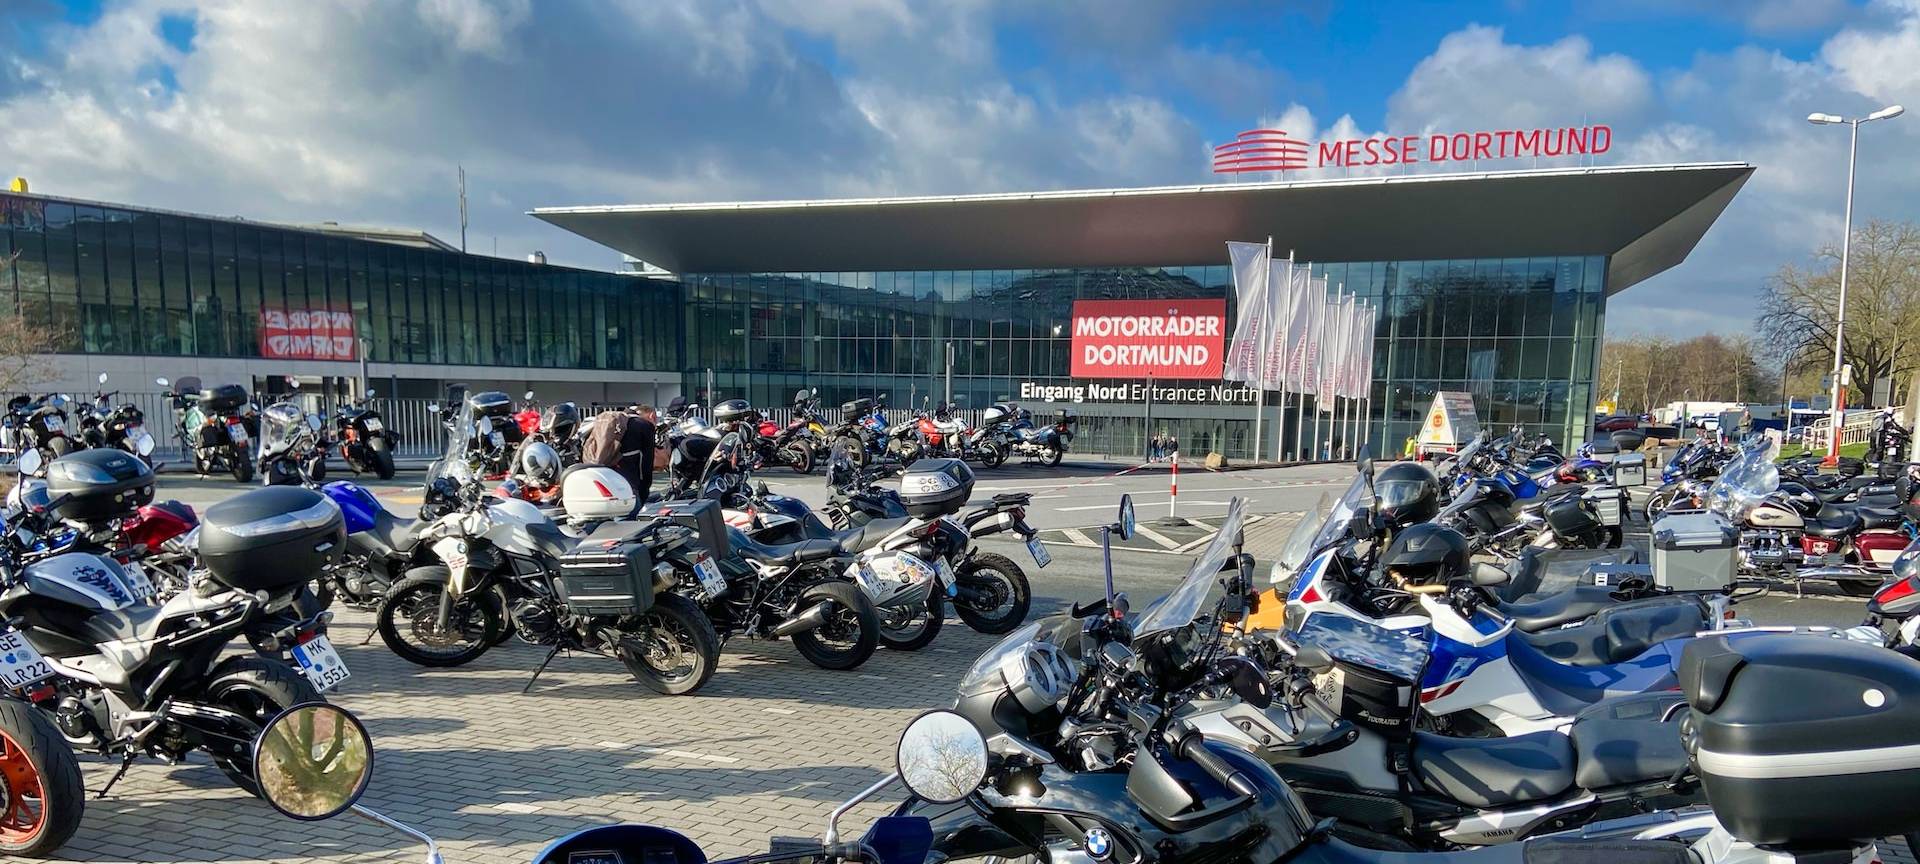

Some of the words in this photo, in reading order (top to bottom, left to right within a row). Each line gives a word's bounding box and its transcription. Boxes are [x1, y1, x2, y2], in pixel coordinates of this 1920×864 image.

[1318, 136, 1419, 168] MESSE
[1429, 126, 1612, 161] DORTMUND
[1076, 308, 1219, 337] MOTORRÄDER
[1085, 344, 1209, 366] DORTMUND
[1020, 382, 1084, 402] Eingang
[1088, 383, 1127, 400] Nord
[1211, 385, 1259, 402] North
[0, 634, 22, 651] GE
[306, 639, 327, 656] MK
[1481, 828, 1515, 838] YAMAHA
